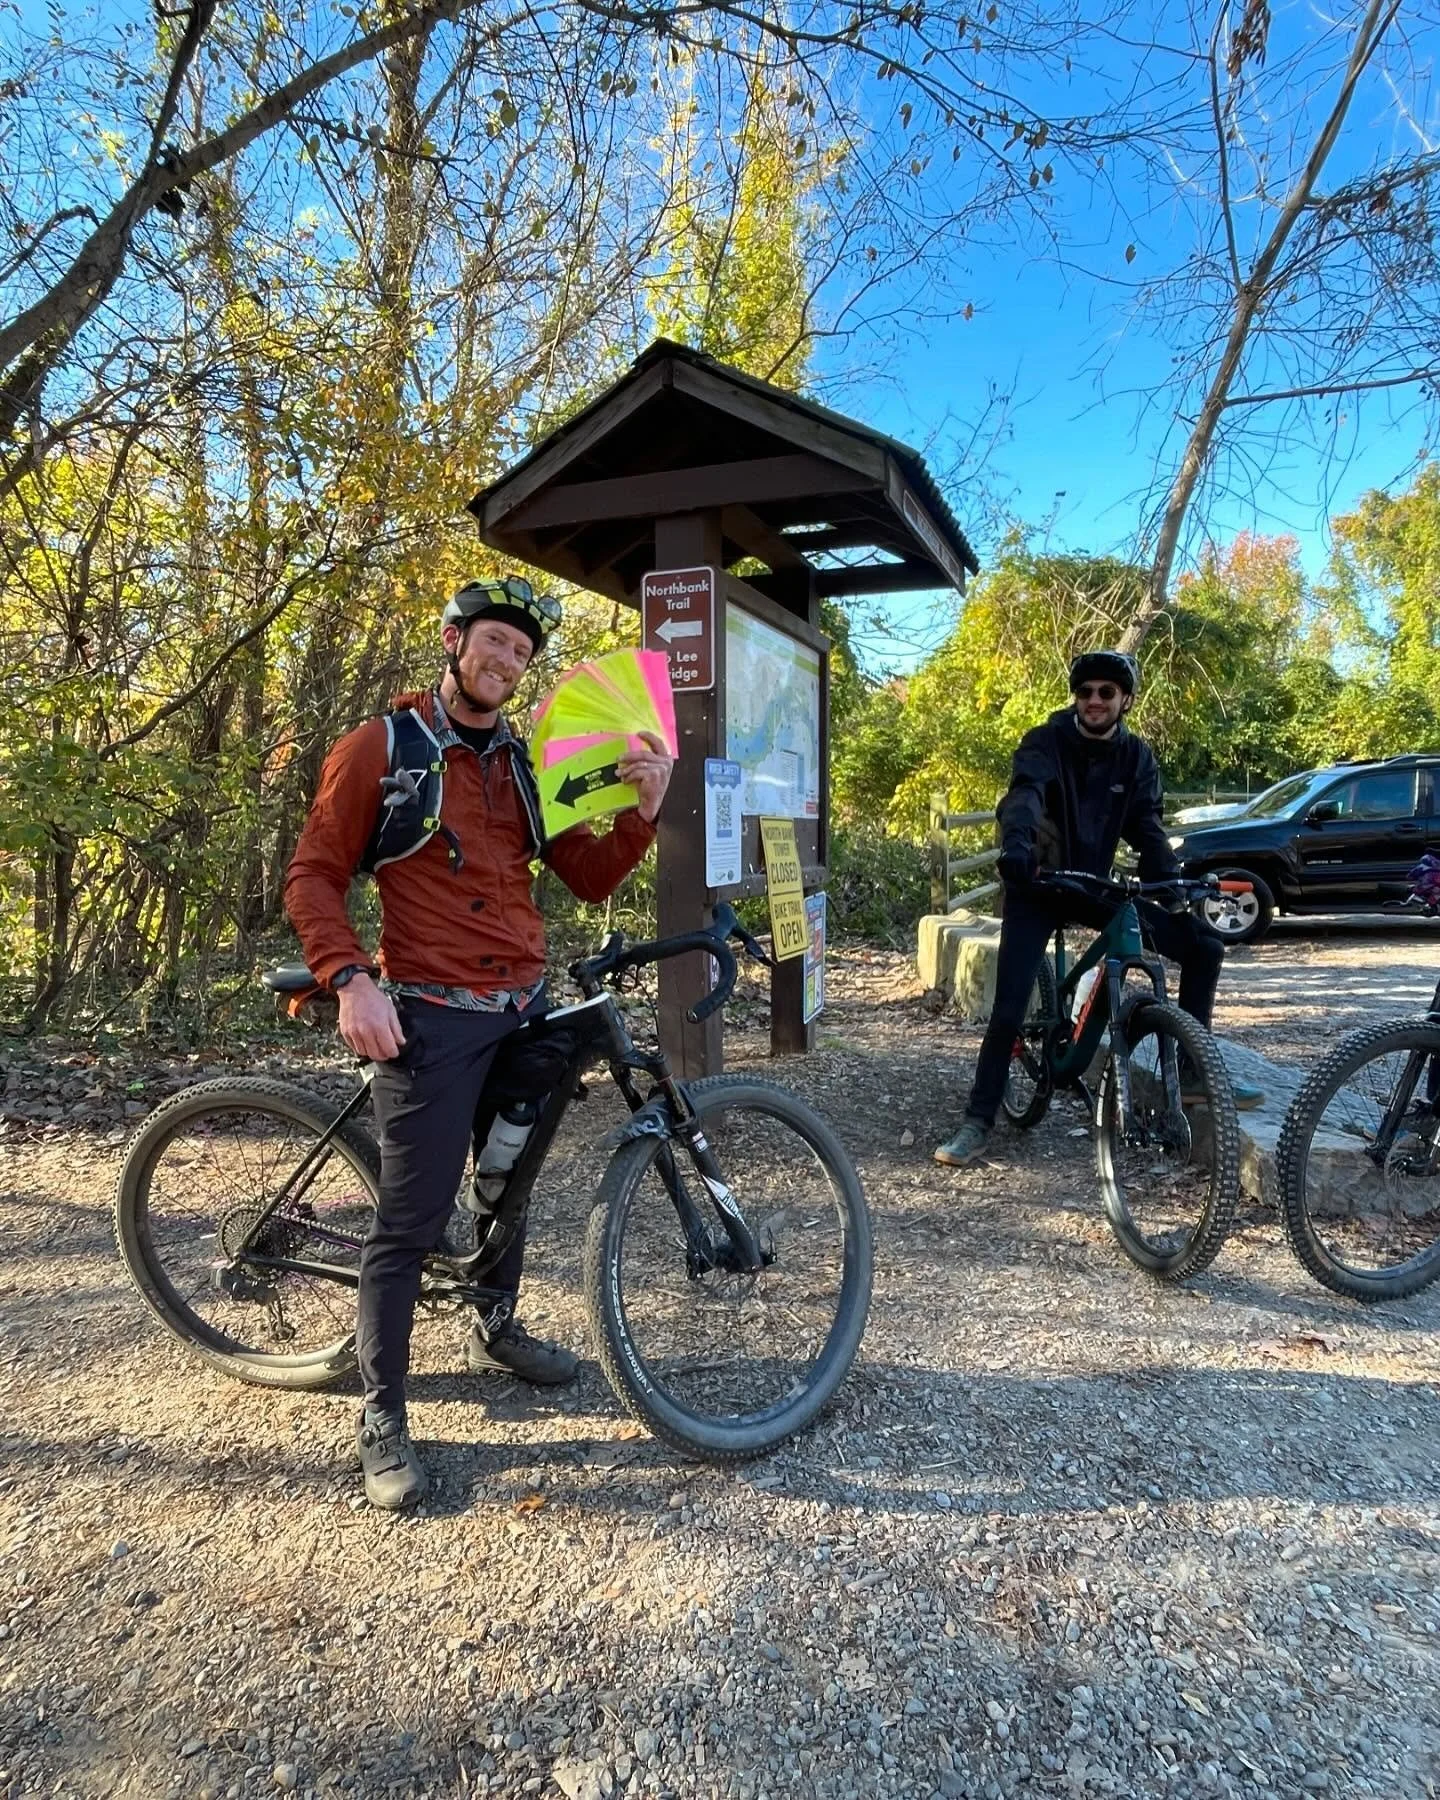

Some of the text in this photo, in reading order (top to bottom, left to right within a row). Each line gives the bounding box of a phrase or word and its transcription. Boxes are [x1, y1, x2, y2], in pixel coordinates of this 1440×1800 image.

[646, 580, 709, 597] Northbank
[666, 597, 690, 611] Trail
[676, 651, 698, 662] Lee
[669, 666, 698, 681] idge
[770, 862, 798, 884] CLOSED
[774, 902, 788, 919] BIKE
[787, 900, 803, 916] TRAIL
[780, 920, 804, 948] OPEN
[611, 1252, 626, 1337] MEZCAL
